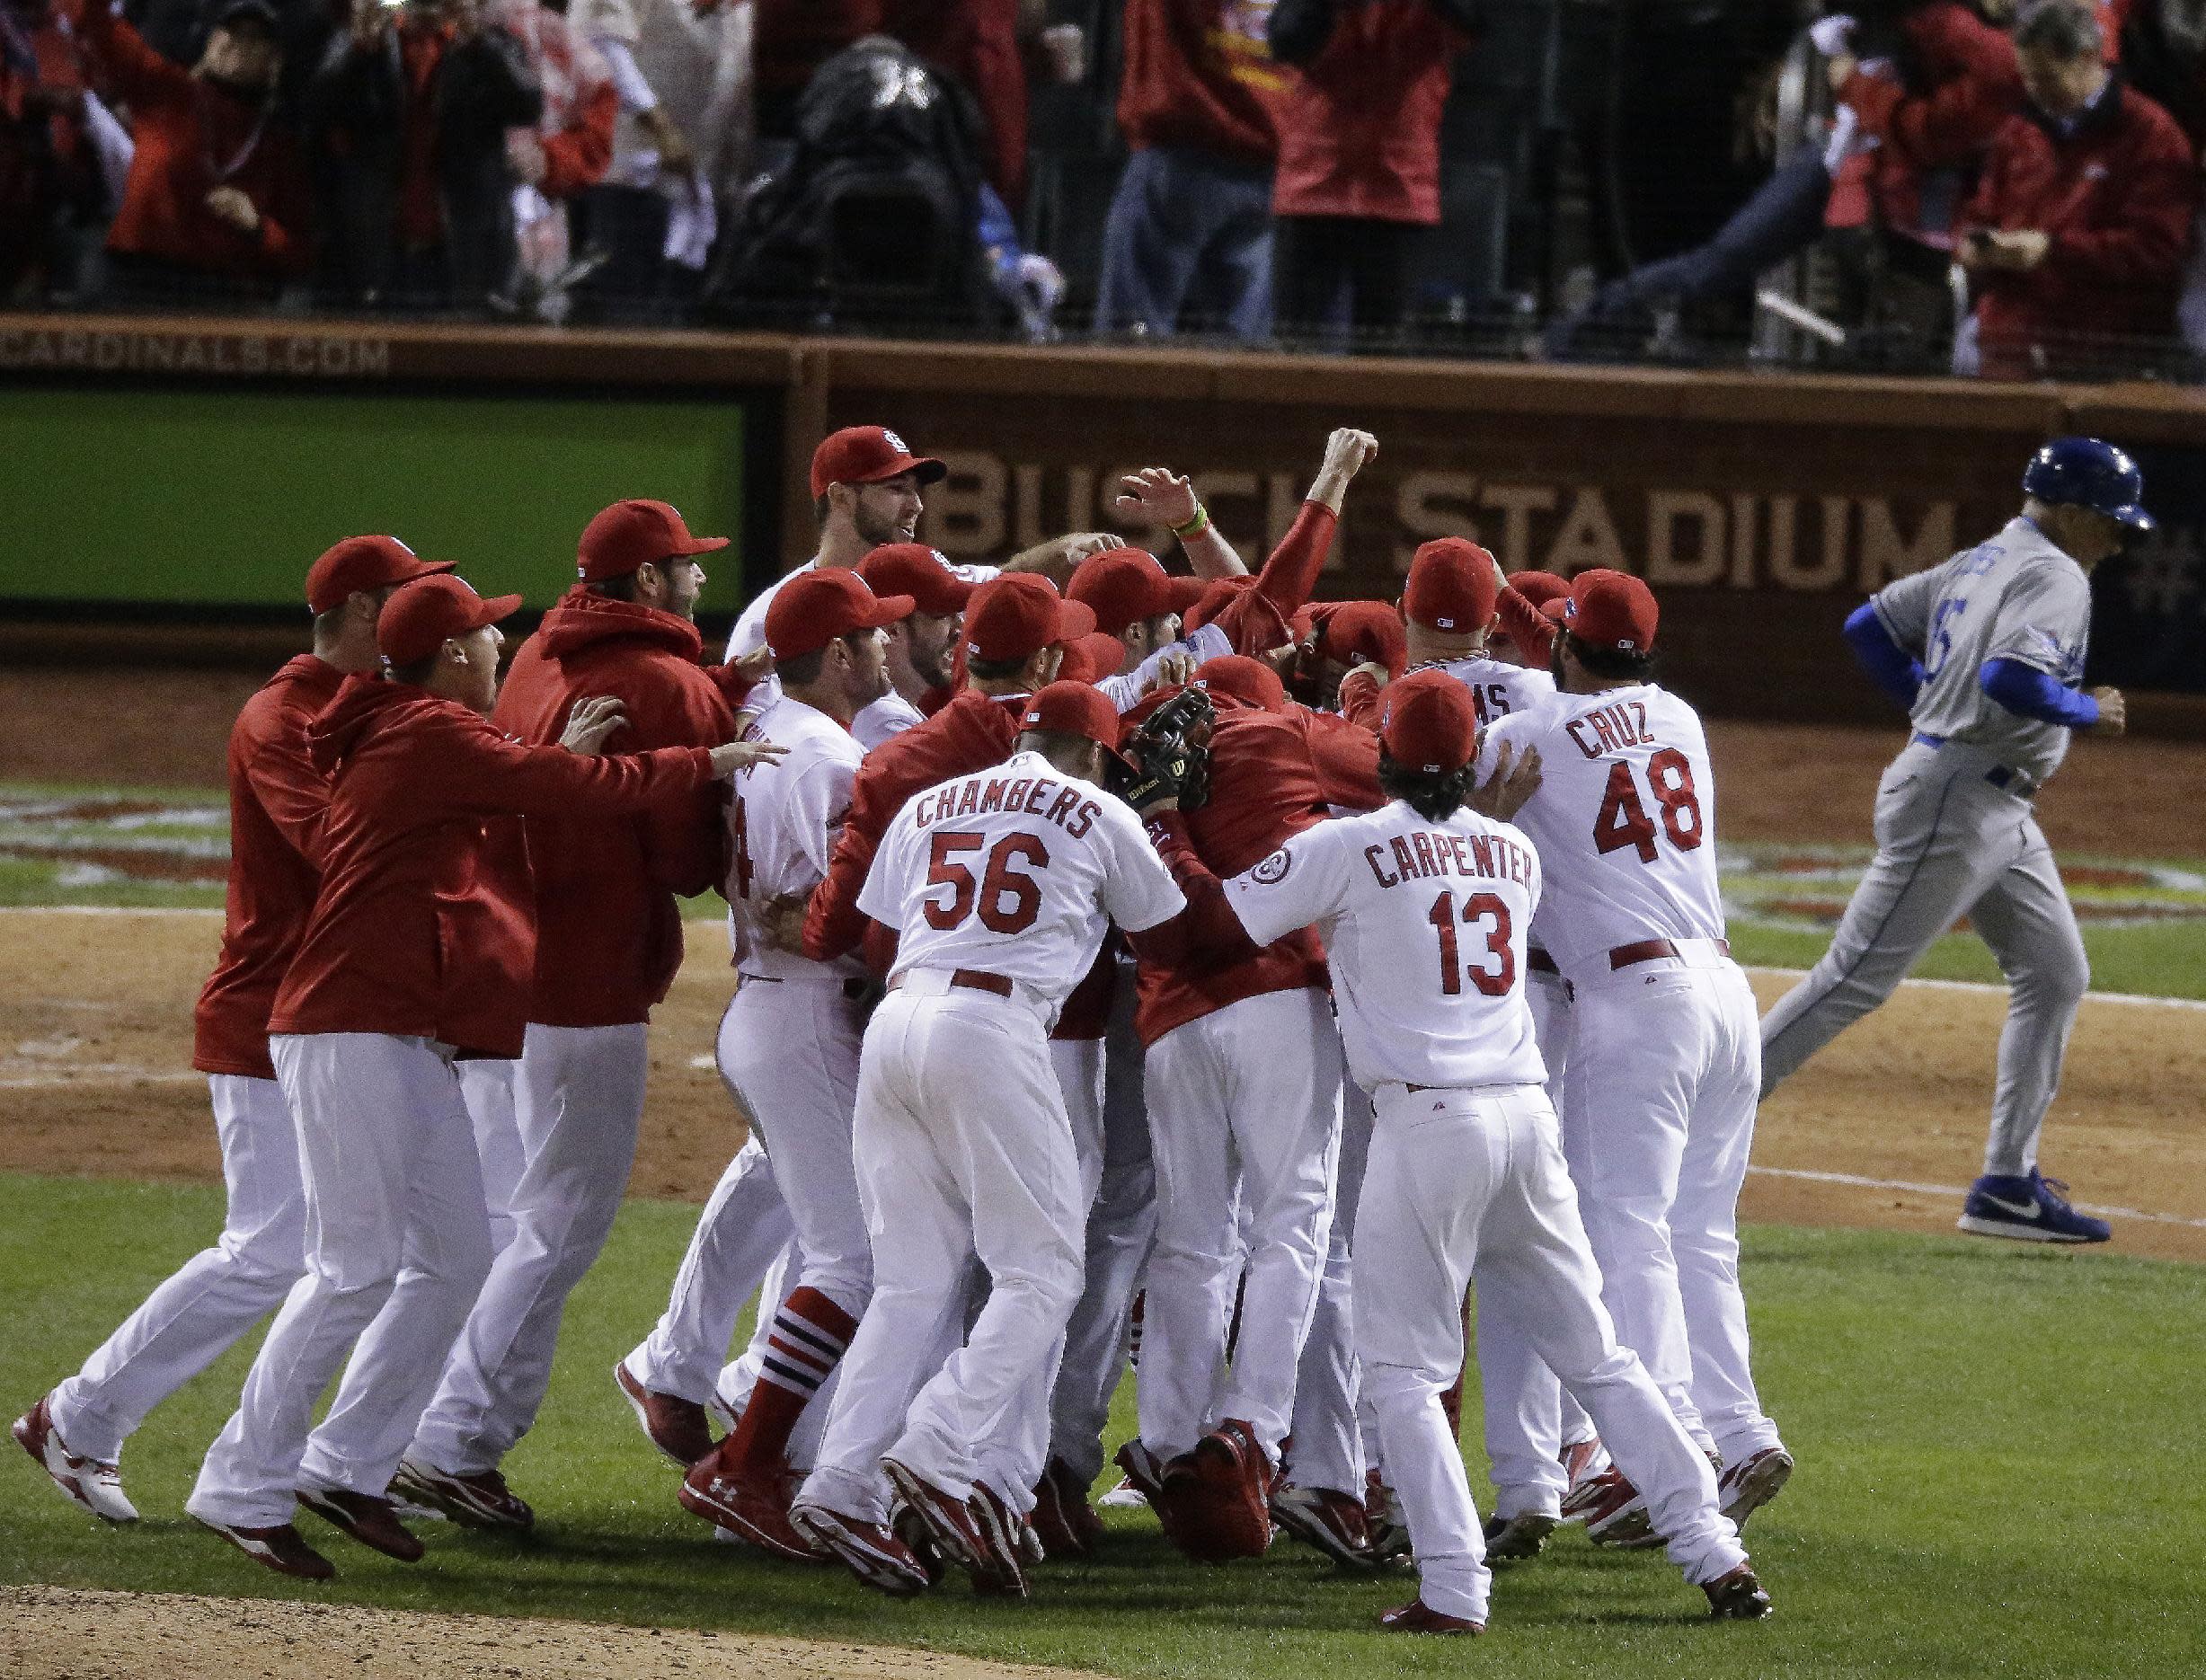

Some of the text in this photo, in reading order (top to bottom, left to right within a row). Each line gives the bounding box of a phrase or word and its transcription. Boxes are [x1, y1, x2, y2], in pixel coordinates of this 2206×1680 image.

[1394, 471, 1957, 593] STADIUM
[1565, 702, 1655, 760] CRUZ
[917, 778, 1103, 839] CHAMBERS
[1593, 747, 1704, 864] 48
[923, 831, 1050, 935] 56
[1363, 832, 1532, 893] CARPENTER
[1429, 890, 1516, 996] 13
